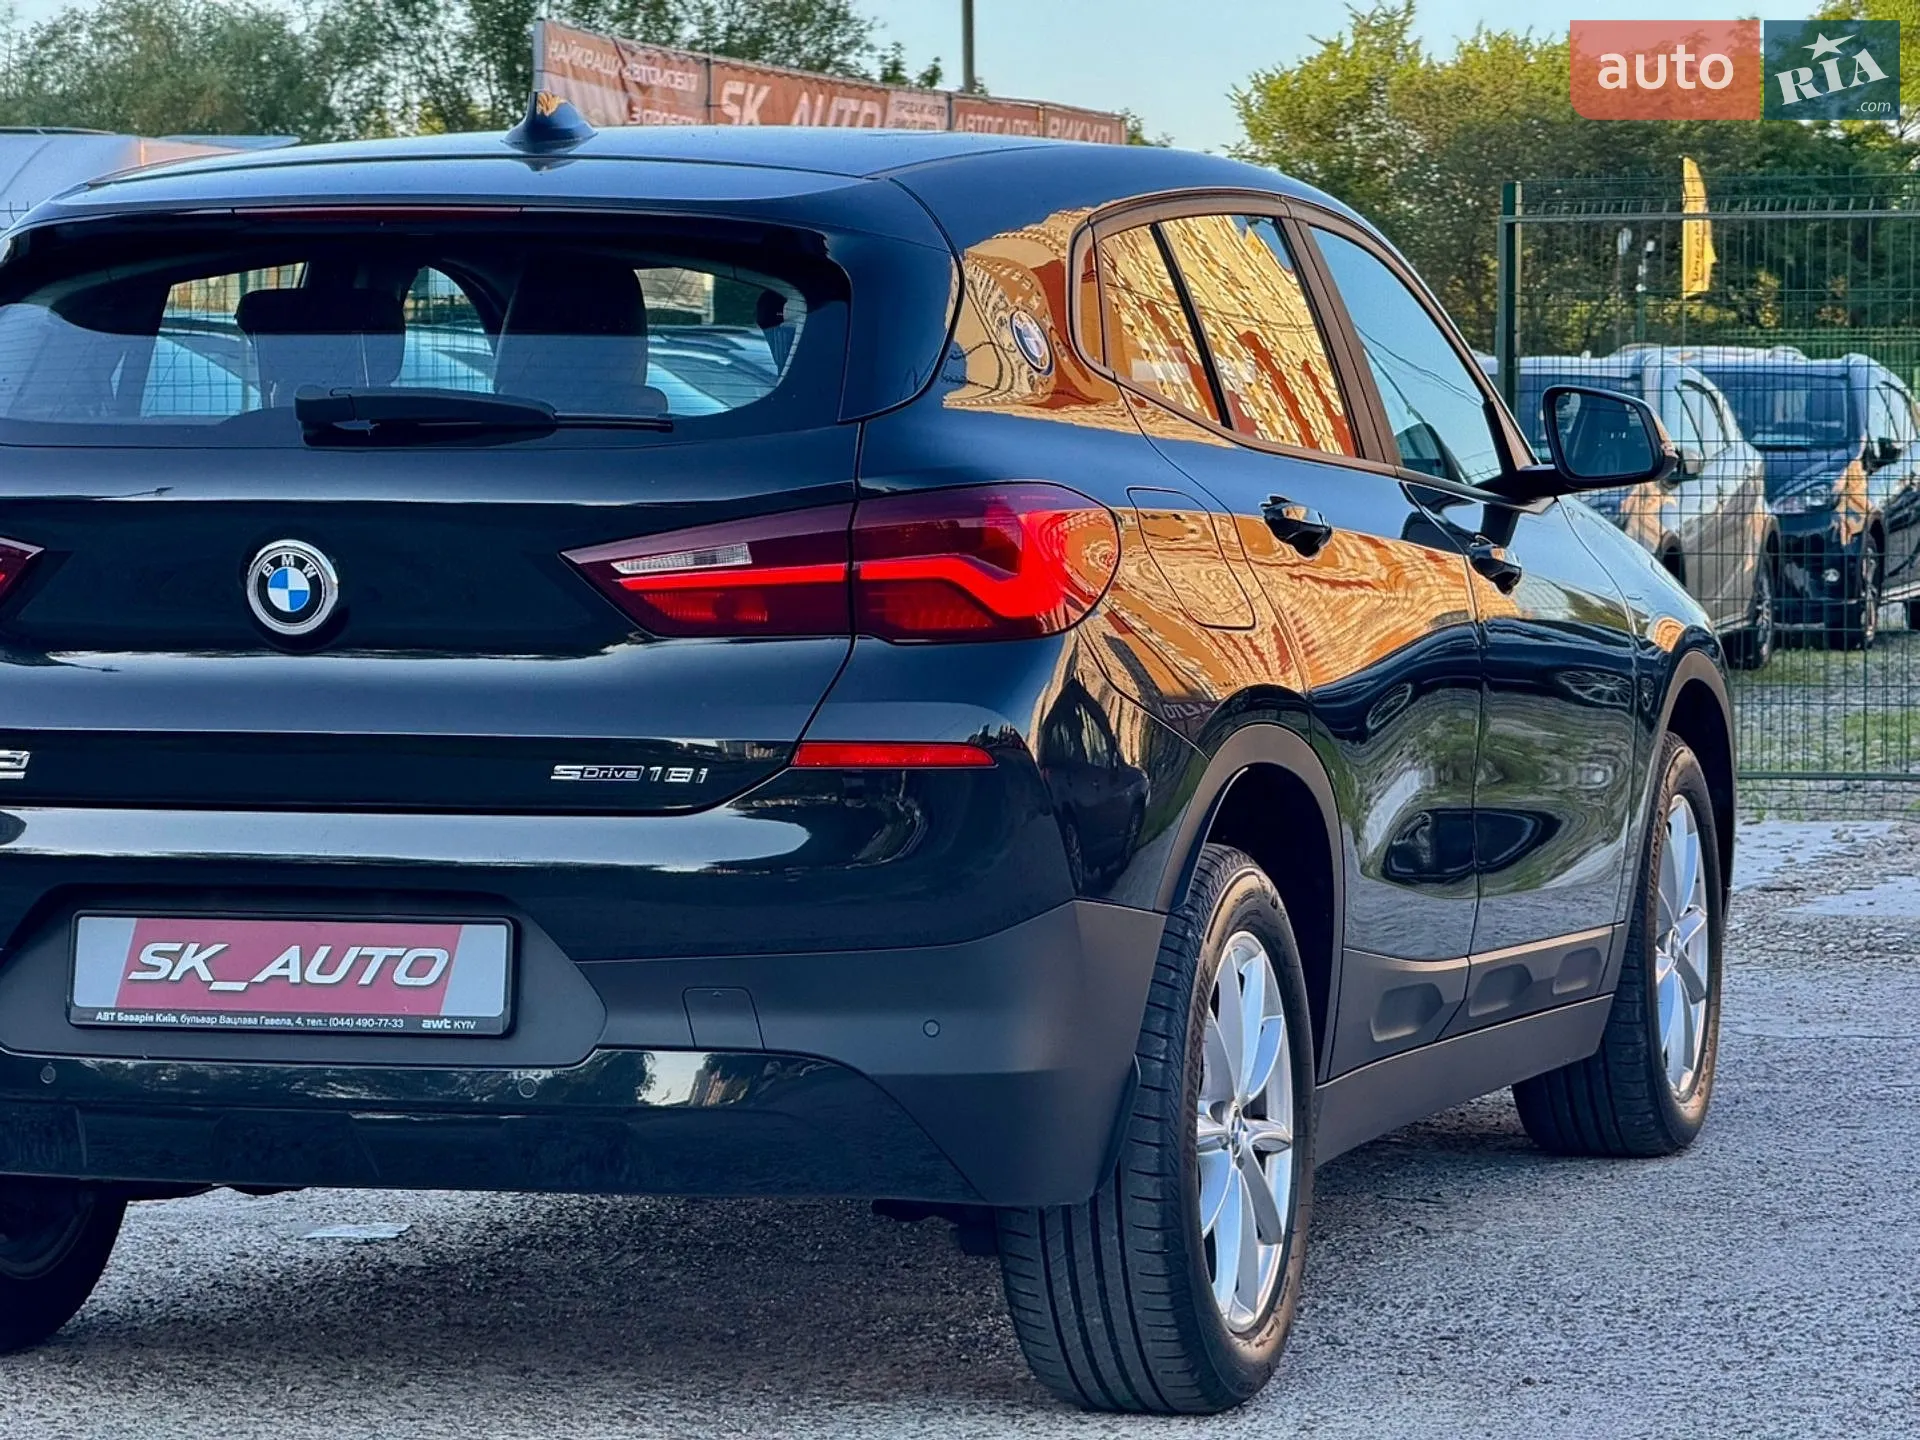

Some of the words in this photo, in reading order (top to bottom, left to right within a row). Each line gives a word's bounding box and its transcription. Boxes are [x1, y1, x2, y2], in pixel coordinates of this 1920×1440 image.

[649, 766, 708, 784] 18i
[127, 942, 450, 992] SK_AUTO
[180, 1013, 217, 1025] бульвар
[218, 1015, 258, 1026] Вацлава
[329, 1018, 354, 1029] (044)
[355, 1018, 404, 1028] 490-77-33
[421, 1018, 451, 1029] awt
[453, 1020, 476, 1029] KYIV
